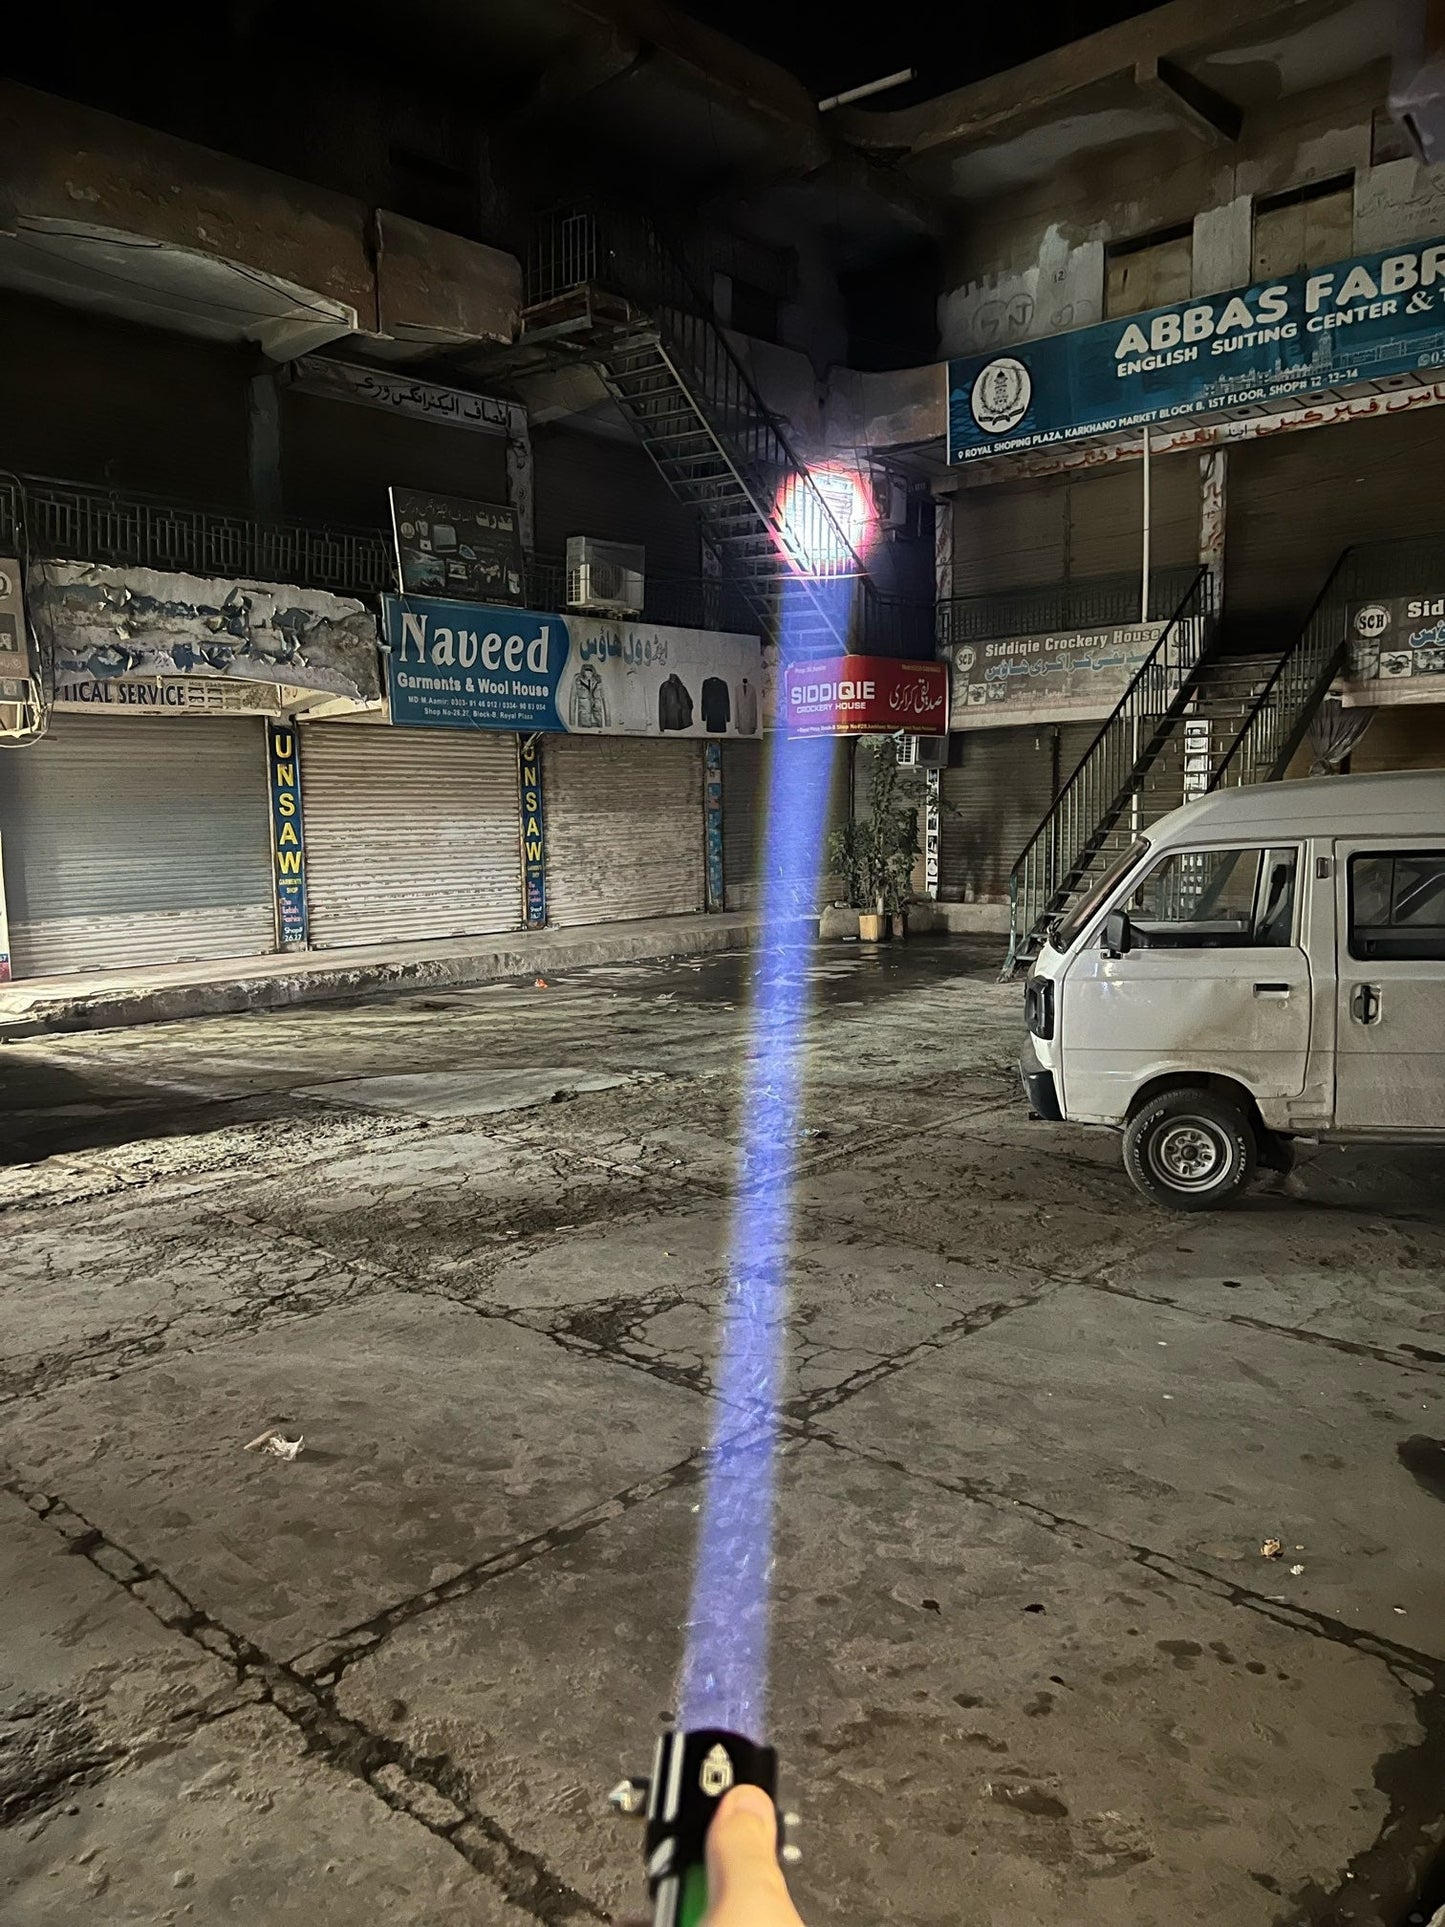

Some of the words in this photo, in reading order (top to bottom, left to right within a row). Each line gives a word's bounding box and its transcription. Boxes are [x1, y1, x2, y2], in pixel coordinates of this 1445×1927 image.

[1115, 286, 1288, 359] ABBAS
[1117, 346, 1198, 378] ENGLISH
[1211, 323, 1297, 356] SUITING
[1306, 299, 1397, 332] CENTER
[1405, 290, 1435, 314] &
[965, 446, 992, 459] ROYAL
[994, 437, 1031, 453] SHOPING
[1065, 419, 1117, 438] KARKHANO
[1119, 410, 1157, 427] MARKET
[1159, 403, 1193, 419] BLOCK
[1208, 396, 1226, 409] 1ST
[1359, 614, 1385, 630] SCH
[399, 612, 550, 674] Naveed
[985, 640, 1040, 657] Siddiqie
[1045, 633, 1108, 651] Crockery
[1112, 628, 1161, 645] House
[119, 682, 185, 706] SERVICE
[397, 671, 461, 692] Garments
[465, 676, 475, 694] &
[477, 677, 509, 696] Wool
[512, 681, 550, 698] House
[791, 681, 876, 706] SIDDIQIE
[424, 706, 441, 717] Shop
[500, 711, 517, 721] Royal
[796, 703, 833, 715] CROCKERY
[835, 701, 867, 711] HOUSE
[275, 734, 302, 875] UNSAW
